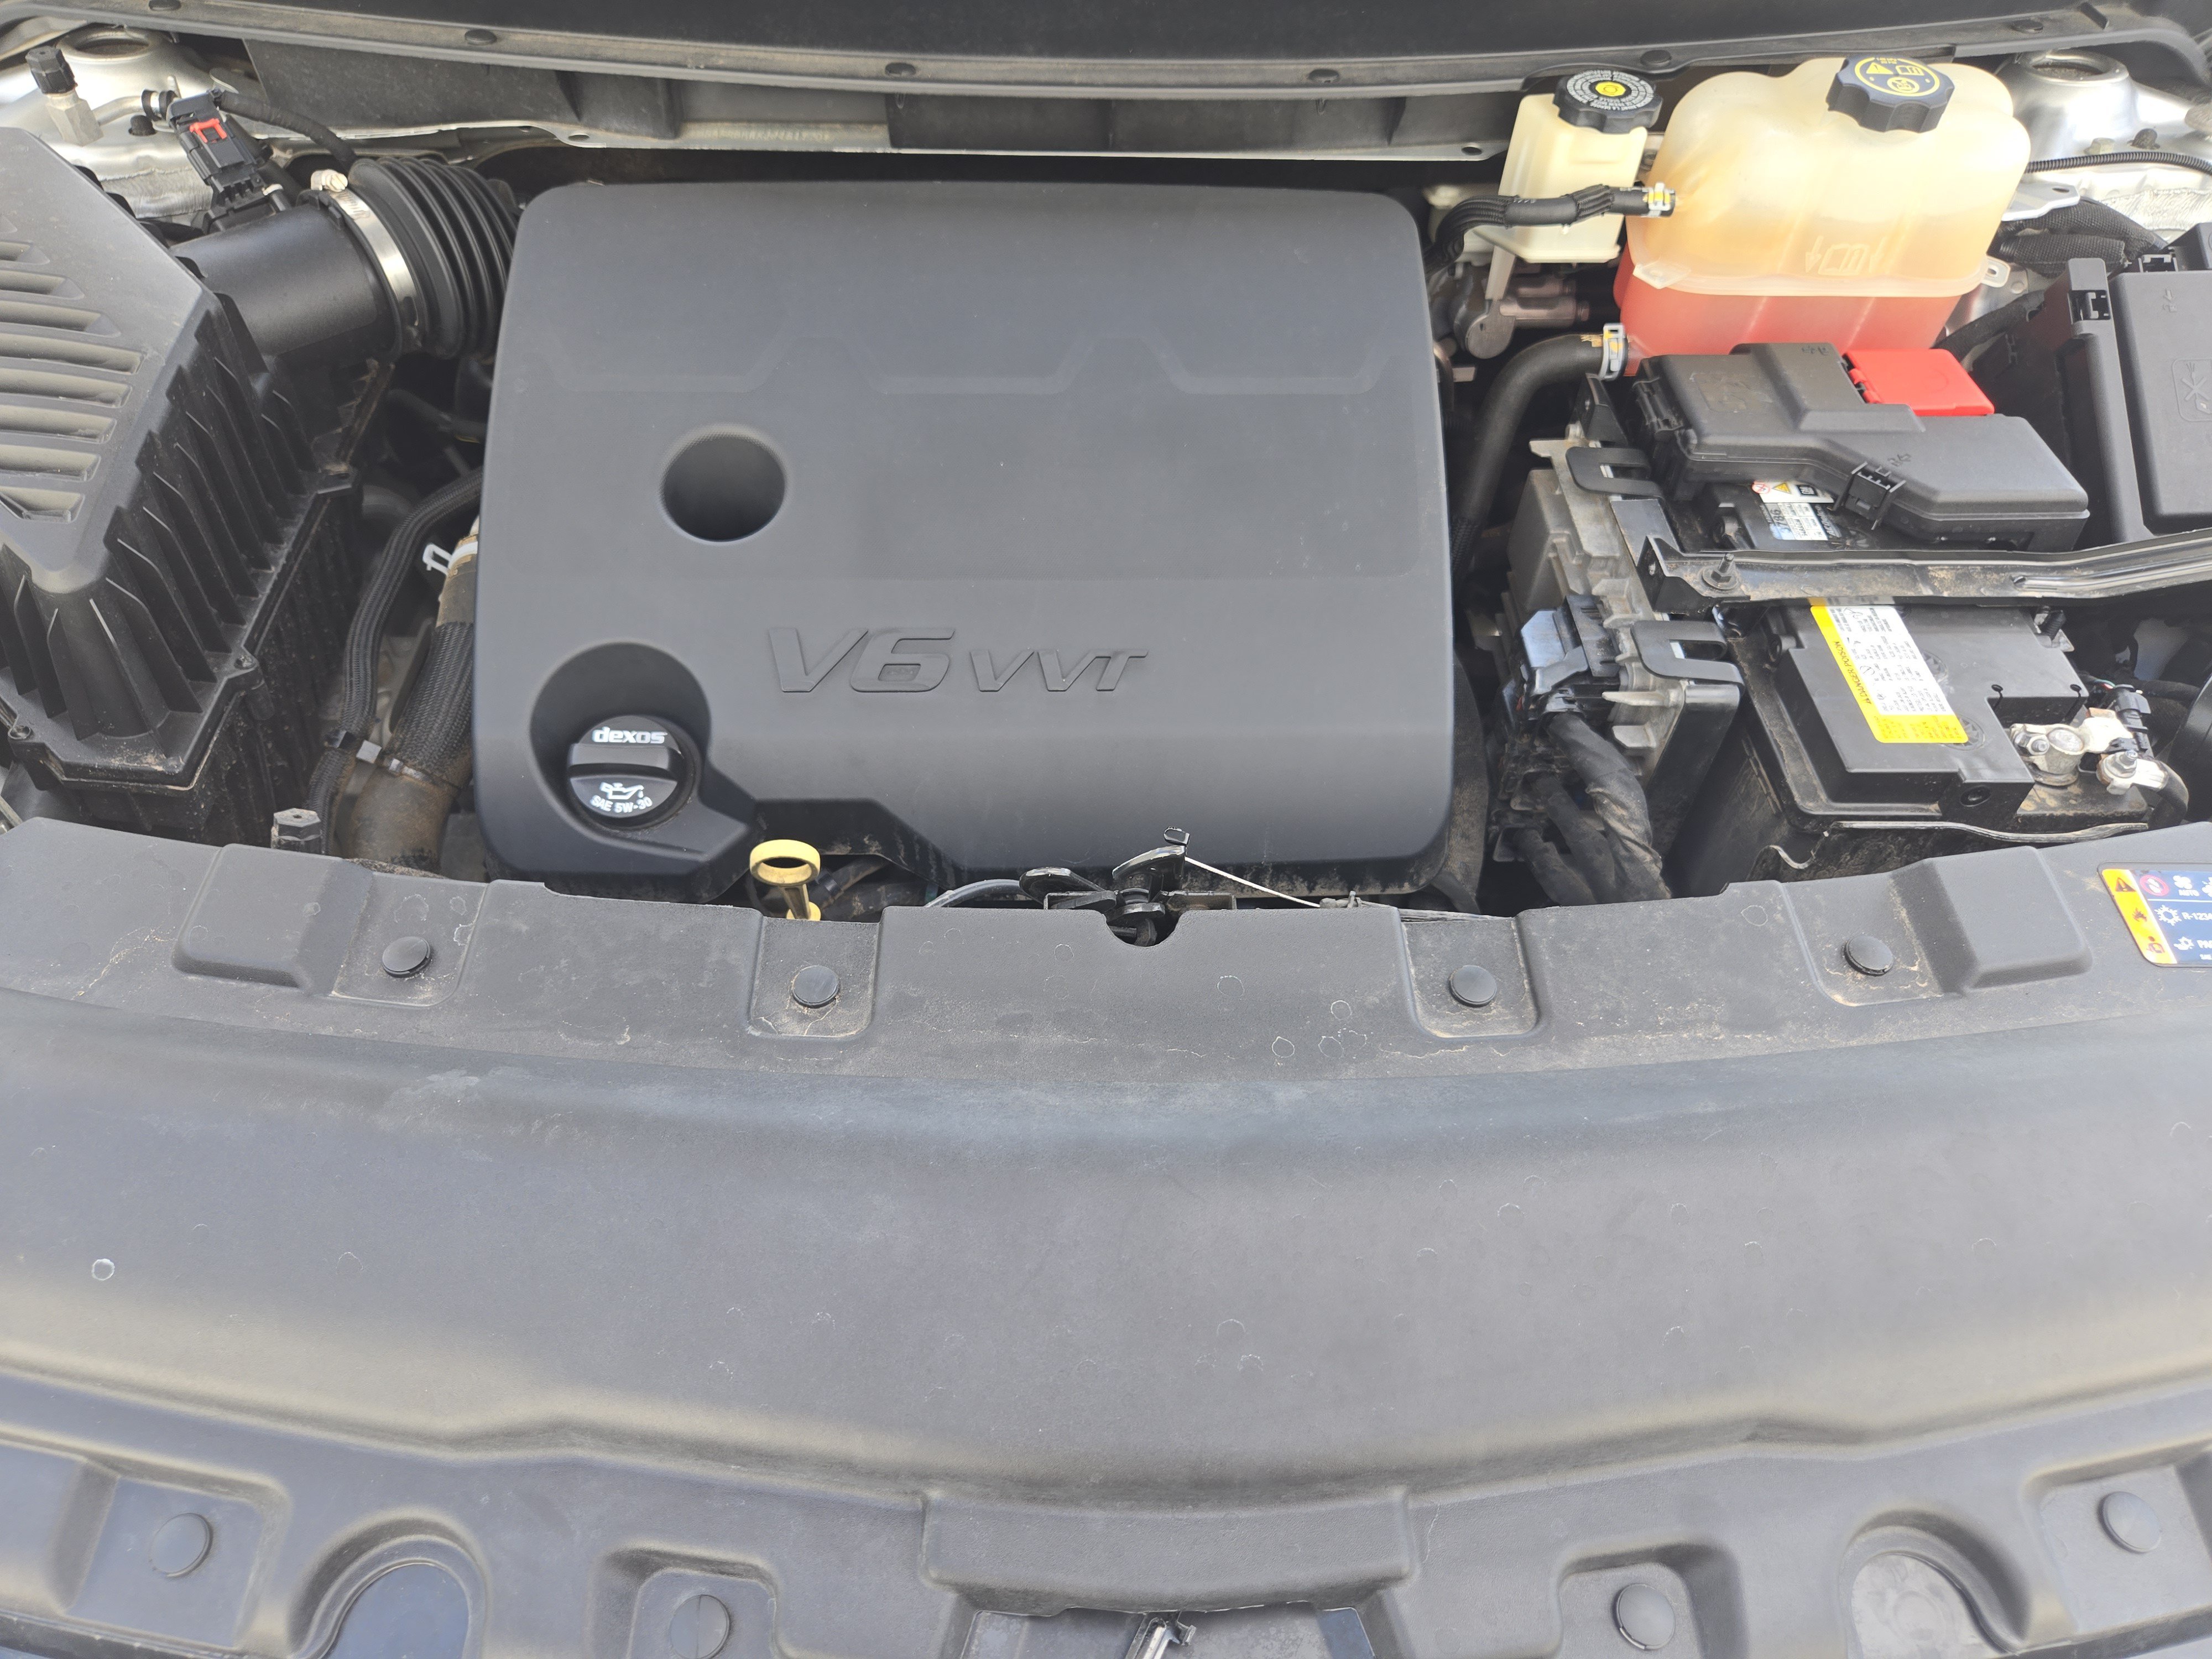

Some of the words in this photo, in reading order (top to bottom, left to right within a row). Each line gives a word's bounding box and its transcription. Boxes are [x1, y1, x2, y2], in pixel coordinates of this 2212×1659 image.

[768, 628, 956, 693] V6
[970, 650, 1149, 692] VVT
[592, 726, 668, 744] dexos
[589, 795, 613, 812] SAE
[614, 796, 653, 813] 5W-30
